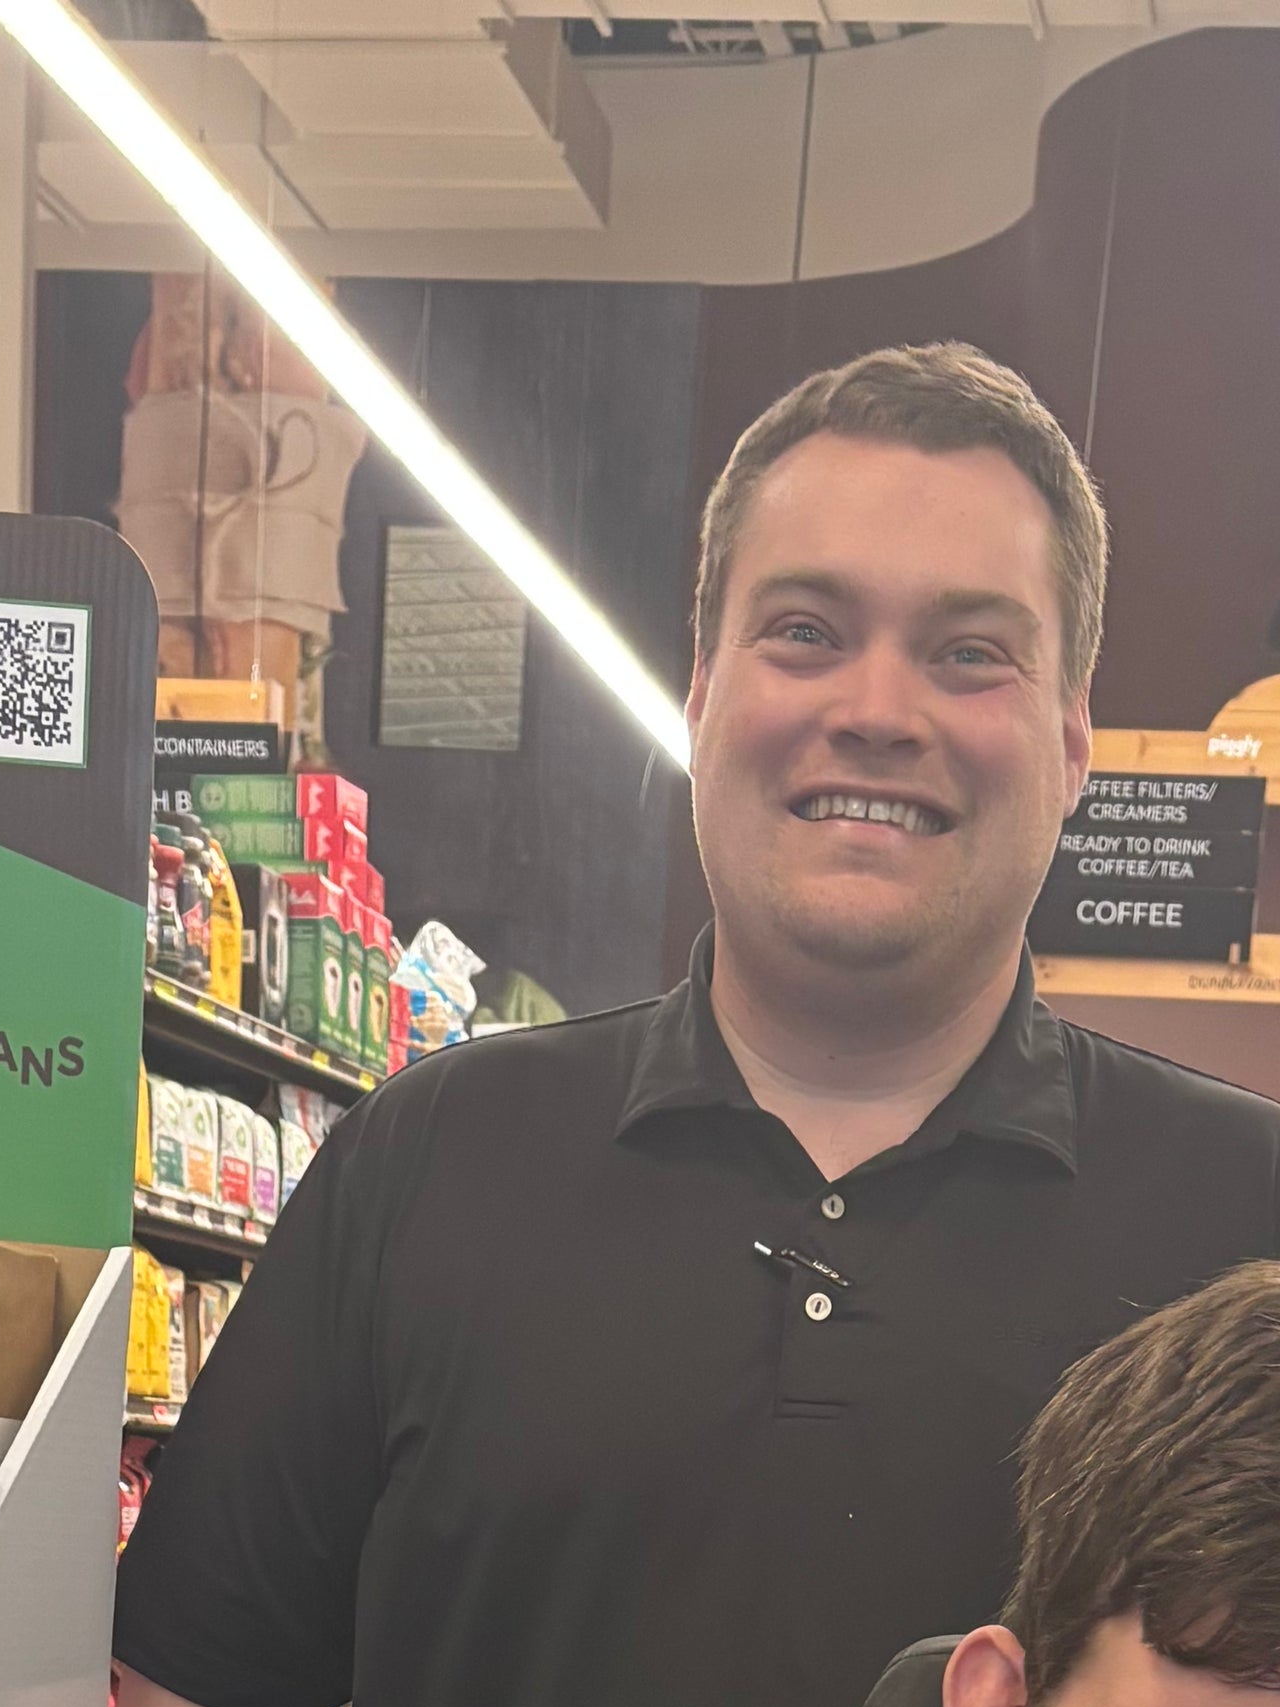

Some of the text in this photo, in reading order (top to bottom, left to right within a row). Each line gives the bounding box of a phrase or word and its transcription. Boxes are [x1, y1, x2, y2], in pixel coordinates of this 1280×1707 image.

[154, 737, 269, 758] CONTAINERS
[1207, 735, 1262, 759] piggly
[1080, 780, 1135, 798] FFEE
[1088, 803, 1188, 822] CREAMERS
[1060, 835, 1212, 856] READY TO DRINK
[1078, 858, 1194, 879] COFFEE/TEA
[1076, 899, 1184, 928] COFFEE
